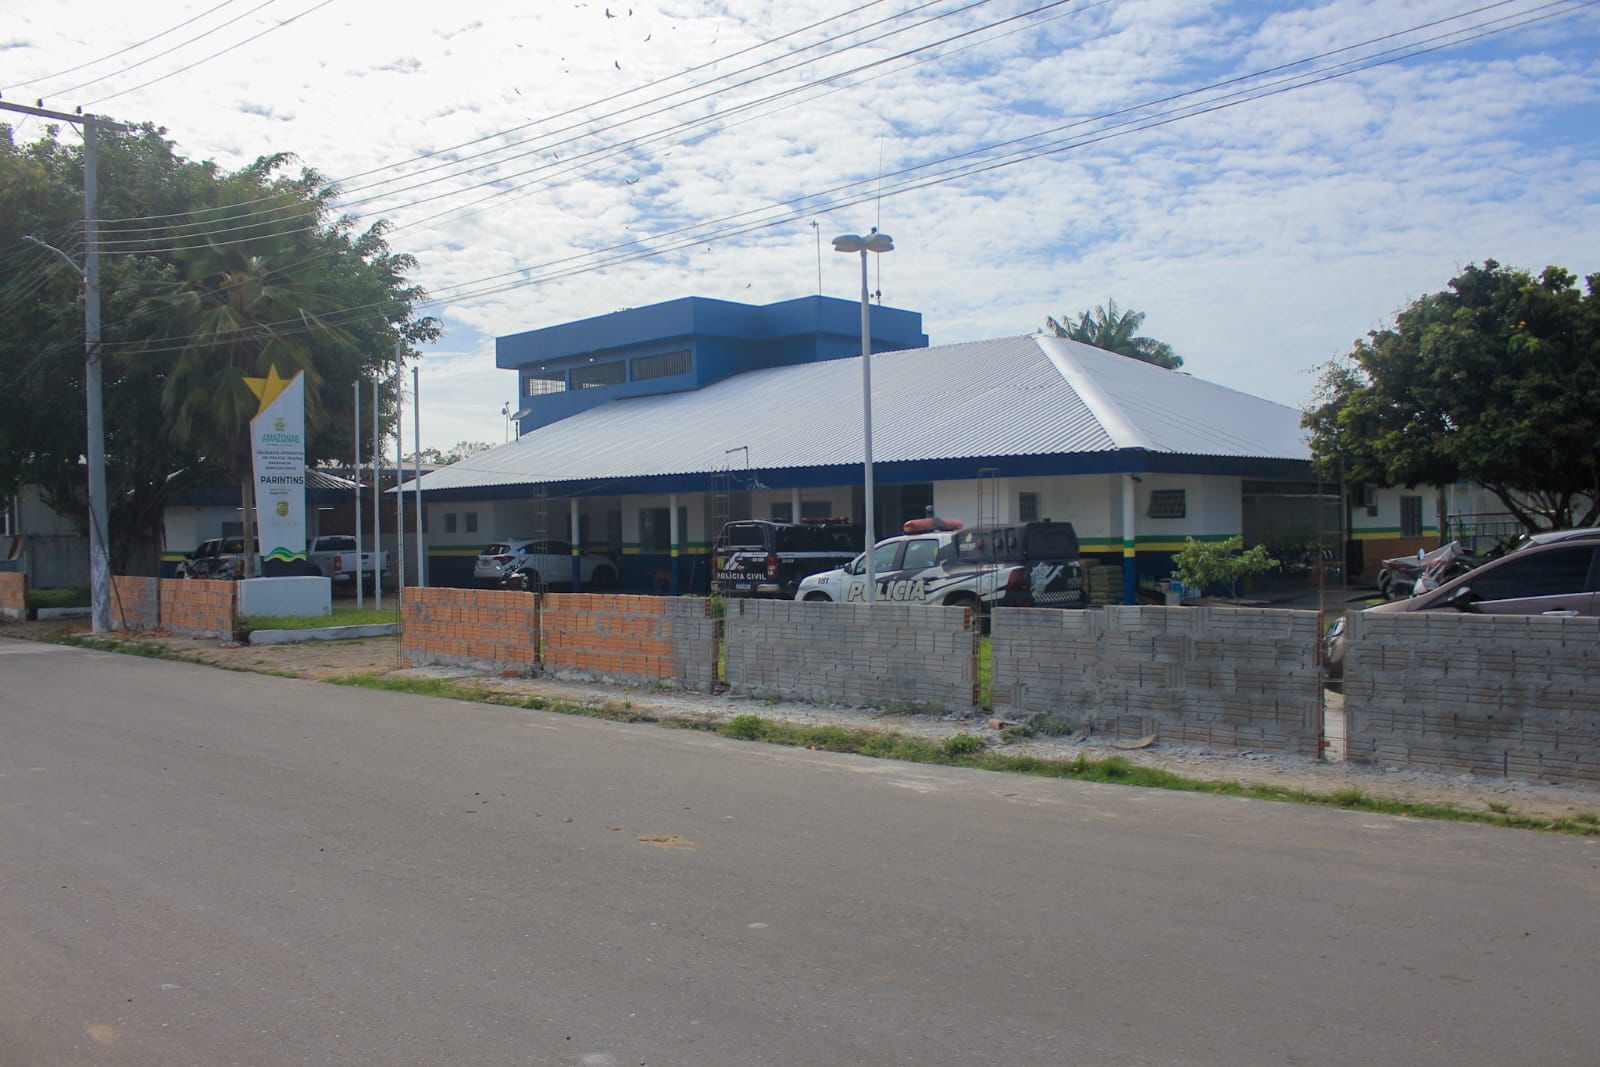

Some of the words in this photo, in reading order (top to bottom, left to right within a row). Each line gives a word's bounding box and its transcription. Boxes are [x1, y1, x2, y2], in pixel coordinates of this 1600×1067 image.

[263, 433, 300, 443] AMAZONAS
[260, 475, 304, 484] PARINTINS
[746, 572, 766, 580] CIVIL
